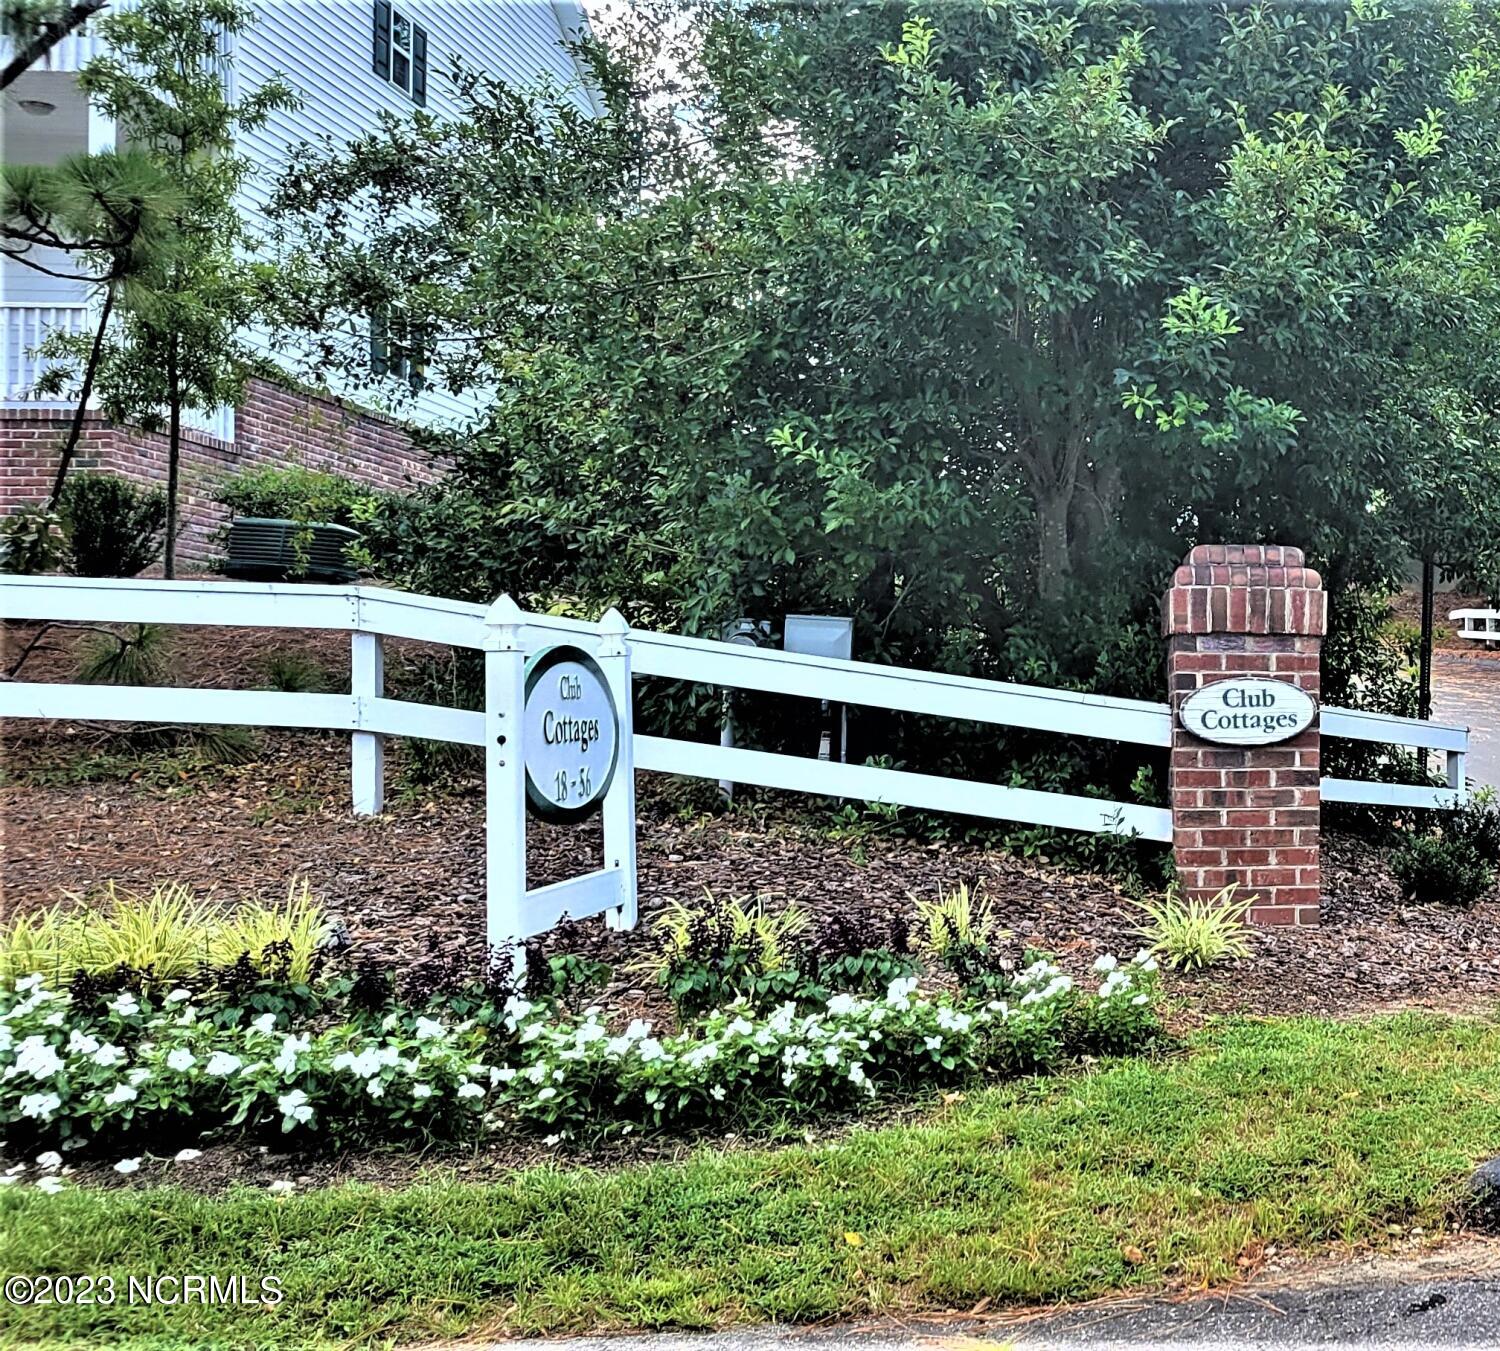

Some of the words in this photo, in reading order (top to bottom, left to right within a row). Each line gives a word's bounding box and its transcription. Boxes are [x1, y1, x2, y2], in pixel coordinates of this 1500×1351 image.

[560, 675, 582, 699] Club
[1222, 688, 1276, 708] Club
[543, 709, 600, 752] Cottages
[1201, 710, 1299, 734] Cottages
[554, 770, 568, 801] 18
[578, 767, 592, 797] 56
